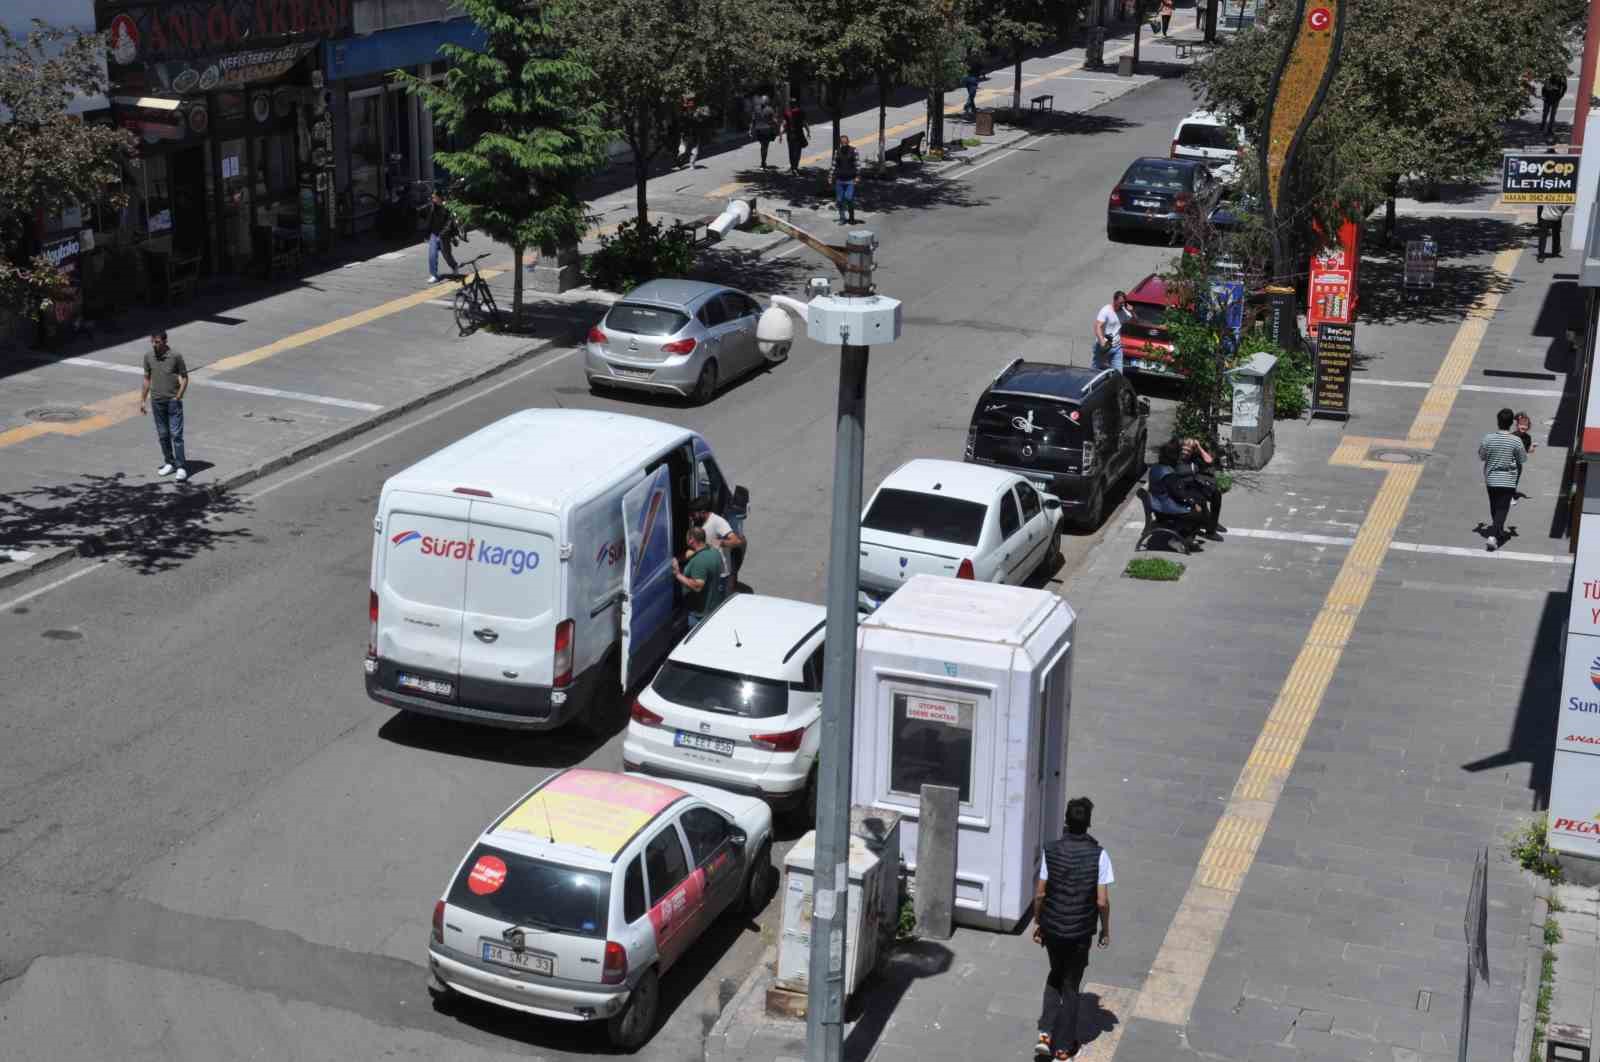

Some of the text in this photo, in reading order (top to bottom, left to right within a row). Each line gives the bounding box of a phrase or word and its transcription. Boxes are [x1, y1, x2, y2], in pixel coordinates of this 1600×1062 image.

[1519, 160, 1575, 176] BeyCep
[1507, 176, 1572, 189] İLETİŞİM
[420, 536, 540, 574] sürat kargo
[1568, 696, 1600, 713] Sun
